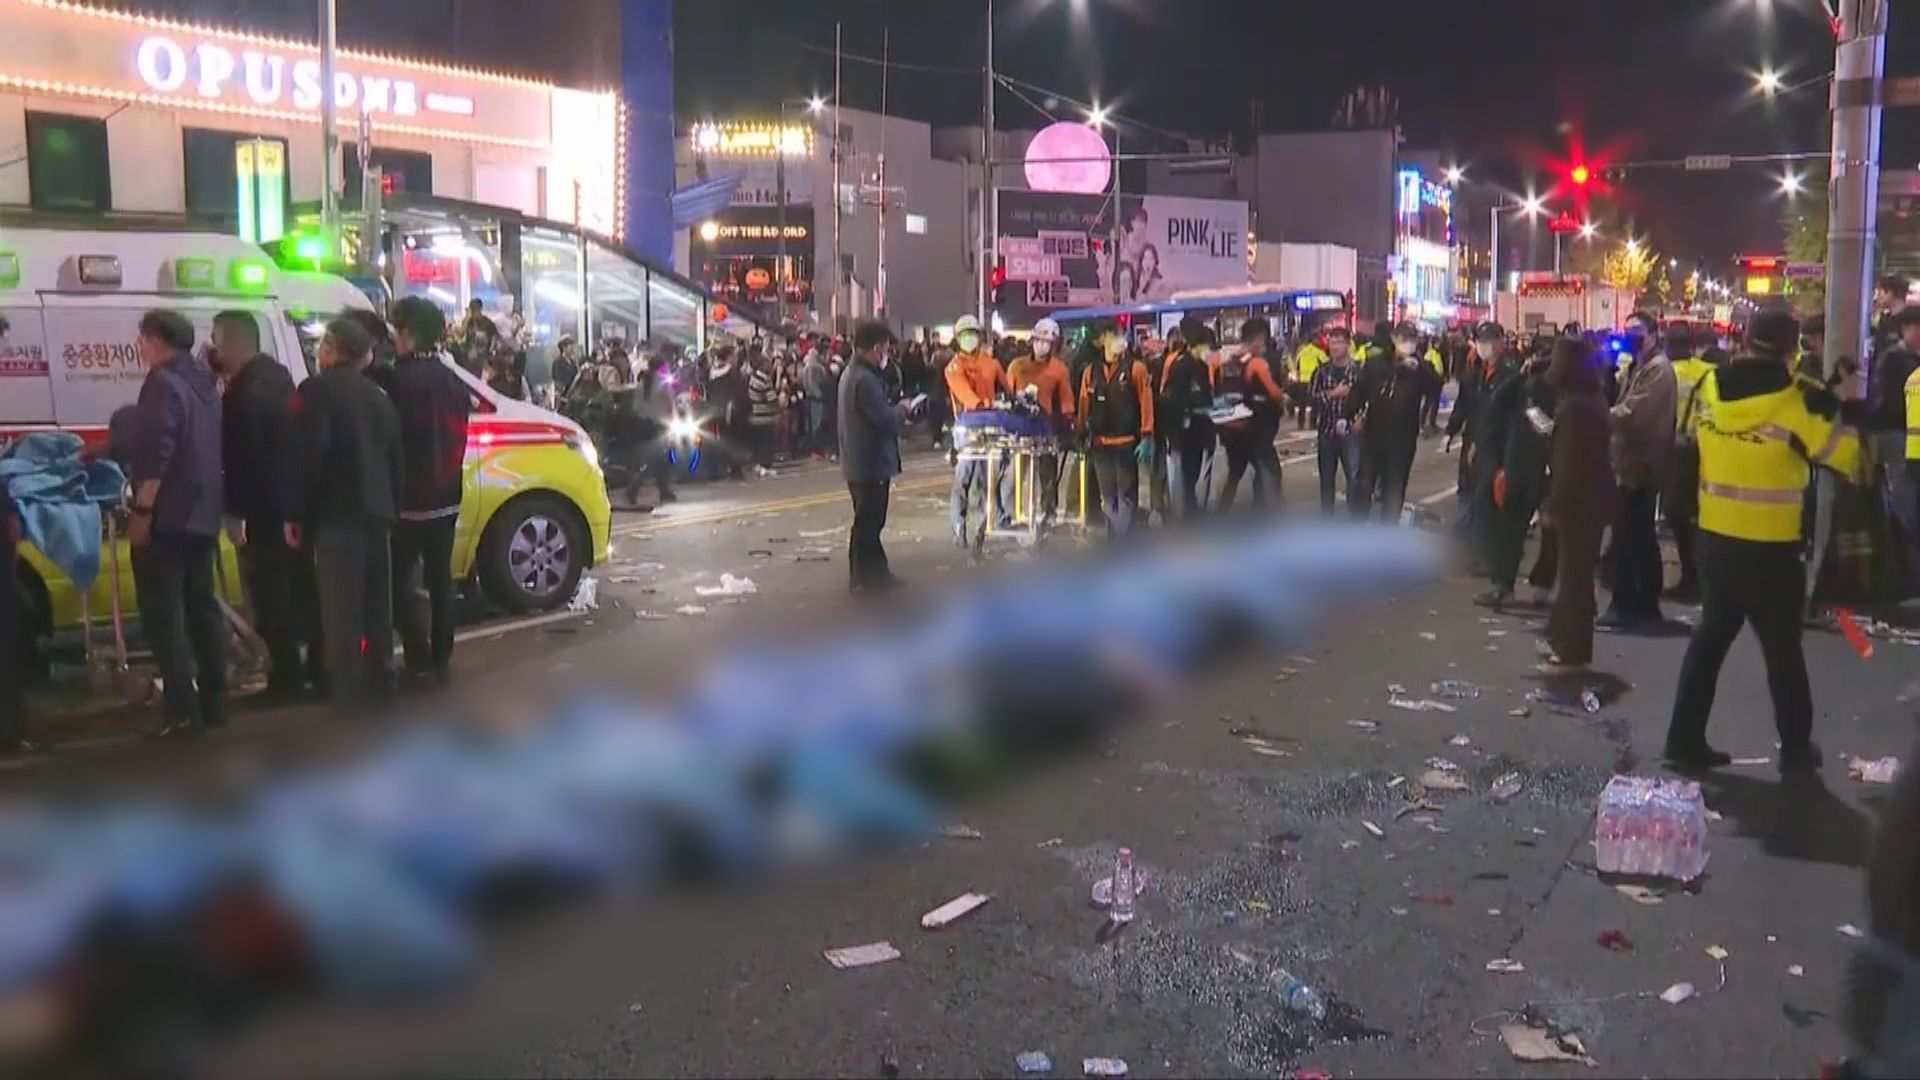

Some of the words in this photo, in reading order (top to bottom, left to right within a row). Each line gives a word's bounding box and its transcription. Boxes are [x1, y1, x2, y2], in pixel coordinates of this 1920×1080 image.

[137, 37, 323, 110] OPUS
[756, 189, 791, 203] Mat
[720, 226, 738, 237] OFF
[740, 226, 762, 237] THE
[763, 226, 807, 238] REORD
[1168, 217, 1209, 247] PINK
[1210, 231, 1238, 258] LIE
[1030, 280, 1069, 304] 처음
